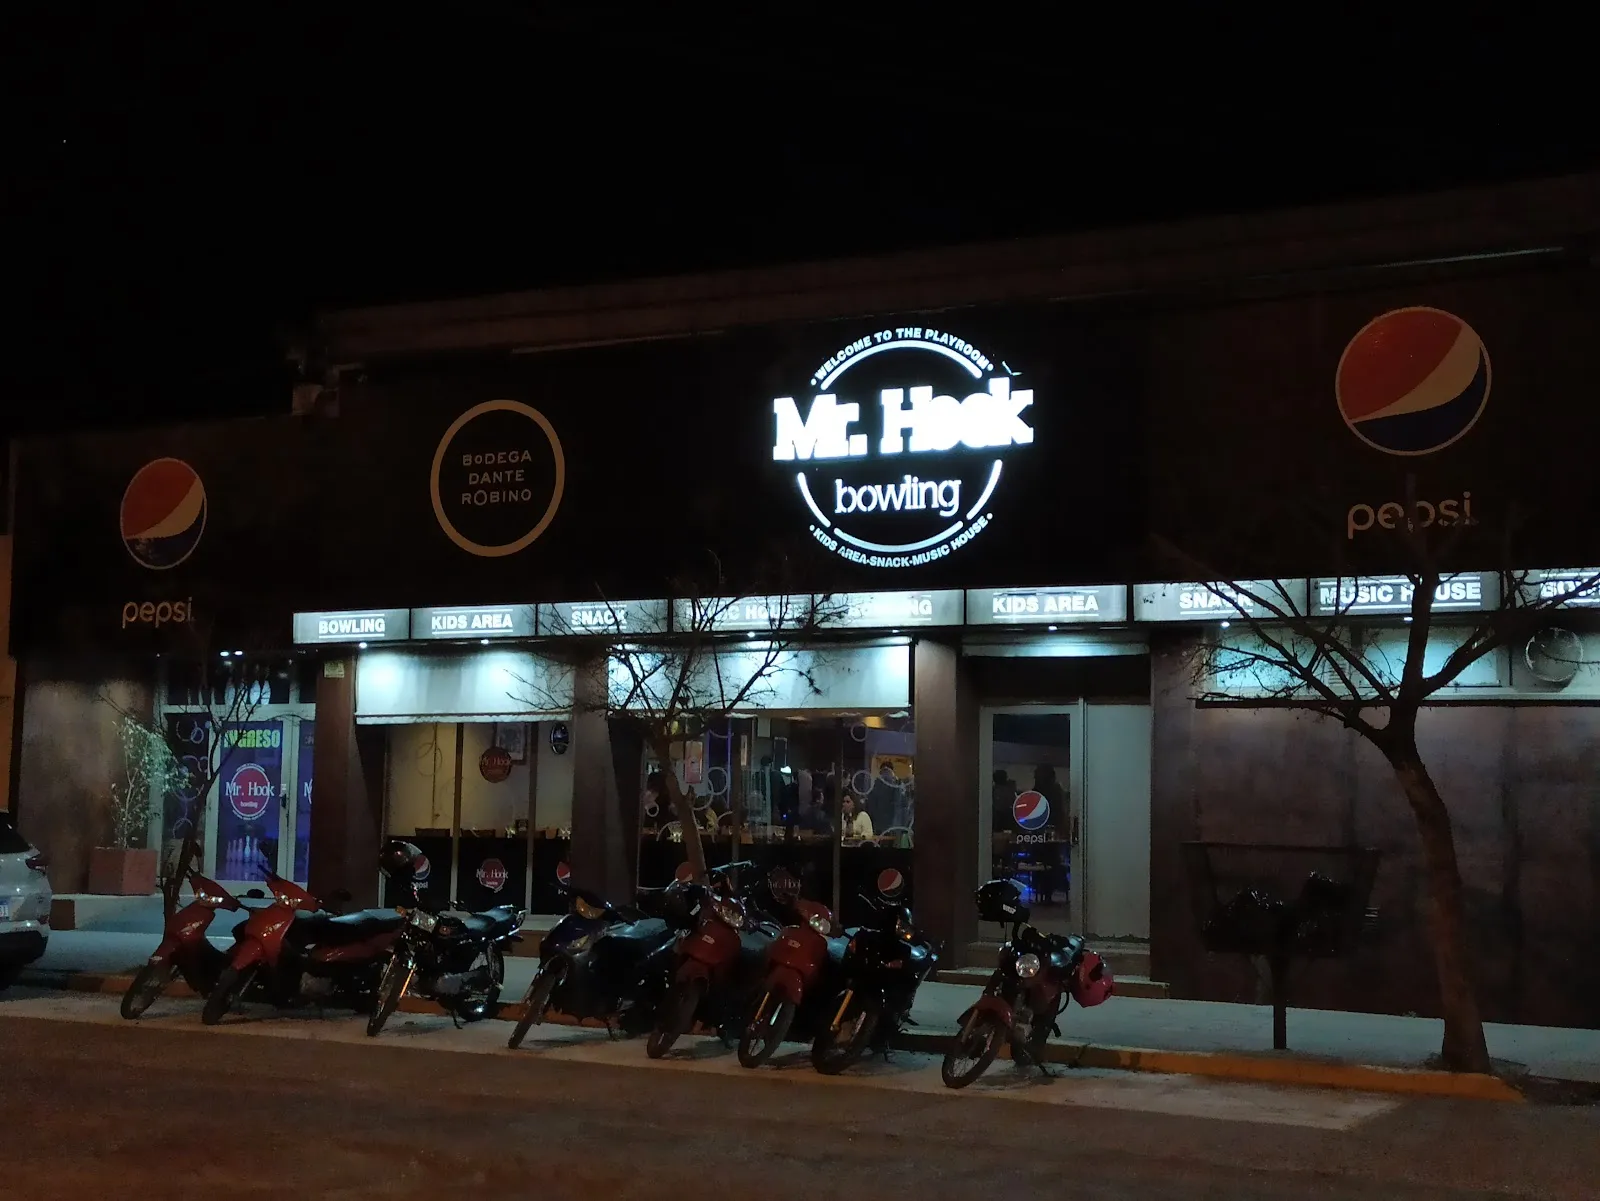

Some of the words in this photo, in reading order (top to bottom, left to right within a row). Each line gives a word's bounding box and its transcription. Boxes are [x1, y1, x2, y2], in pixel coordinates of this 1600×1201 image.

[814, 335, 872, 380] WELCOME
[874, 330, 893, 343] TO
[895, 327, 922, 340] THE
[924, 328, 991, 370] PLAYROOM
[773, 393, 868, 460] Mr.
[880, 376, 1034, 454] Hook
[469, 469, 525, 485] DANTE
[461, 488, 533, 506] ROBINO
[834, 474, 962, 517] bowling
[812, 527, 839, 551] KIDS
[950, 515, 989, 550] HOUSE
[1319, 584, 1394, 606] MUSIC
[1400, 582, 1482, 604] HUSE
[121, 596, 193, 629] pepsi
[993, 595, 1039, 613] KIDS
[1043, 594, 1099, 612] AREA
[318, 617, 386, 635] BOWLING
[432, 614, 468, 630] KIDS
[471, 613, 513, 629] AREA
[571, 609, 628, 626] SNACK
[225, 781, 245, 796] Mr.
[248, 781, 275, 797] Hook
[1016, 832, 1047, 845] pepsi
